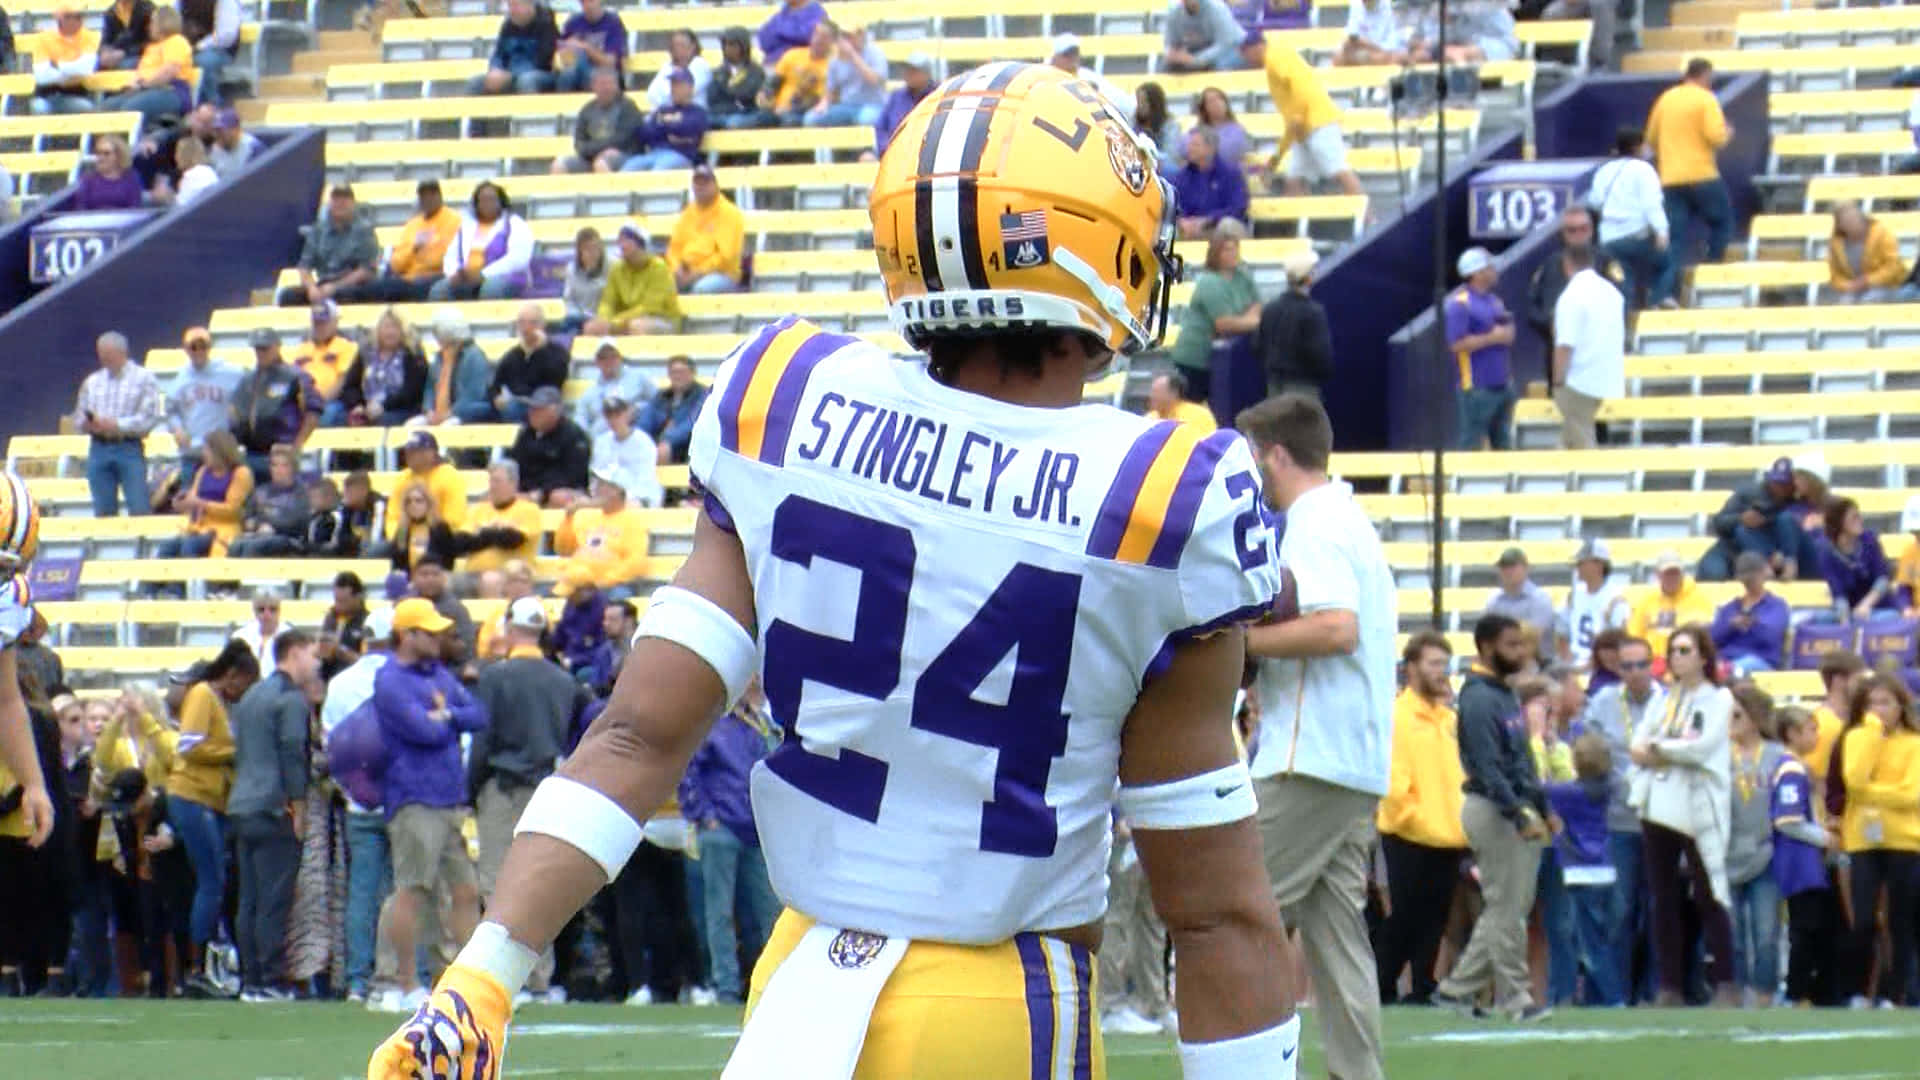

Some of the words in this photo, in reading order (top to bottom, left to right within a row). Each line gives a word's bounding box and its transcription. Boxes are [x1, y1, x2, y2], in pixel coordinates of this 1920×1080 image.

[1486, 189, 1555, 231] 103
[44, 238, 104, 277] 102
[906, 253, 919, 275] 2
[988, 251, 999, 271] 4
[901, 296, 1025, 319] TIGERS
[798, 391, 1018, 512] STINGLEY
[1012, 448, 1080, 526] JR.
[763, 493, 1083, 858] 24
